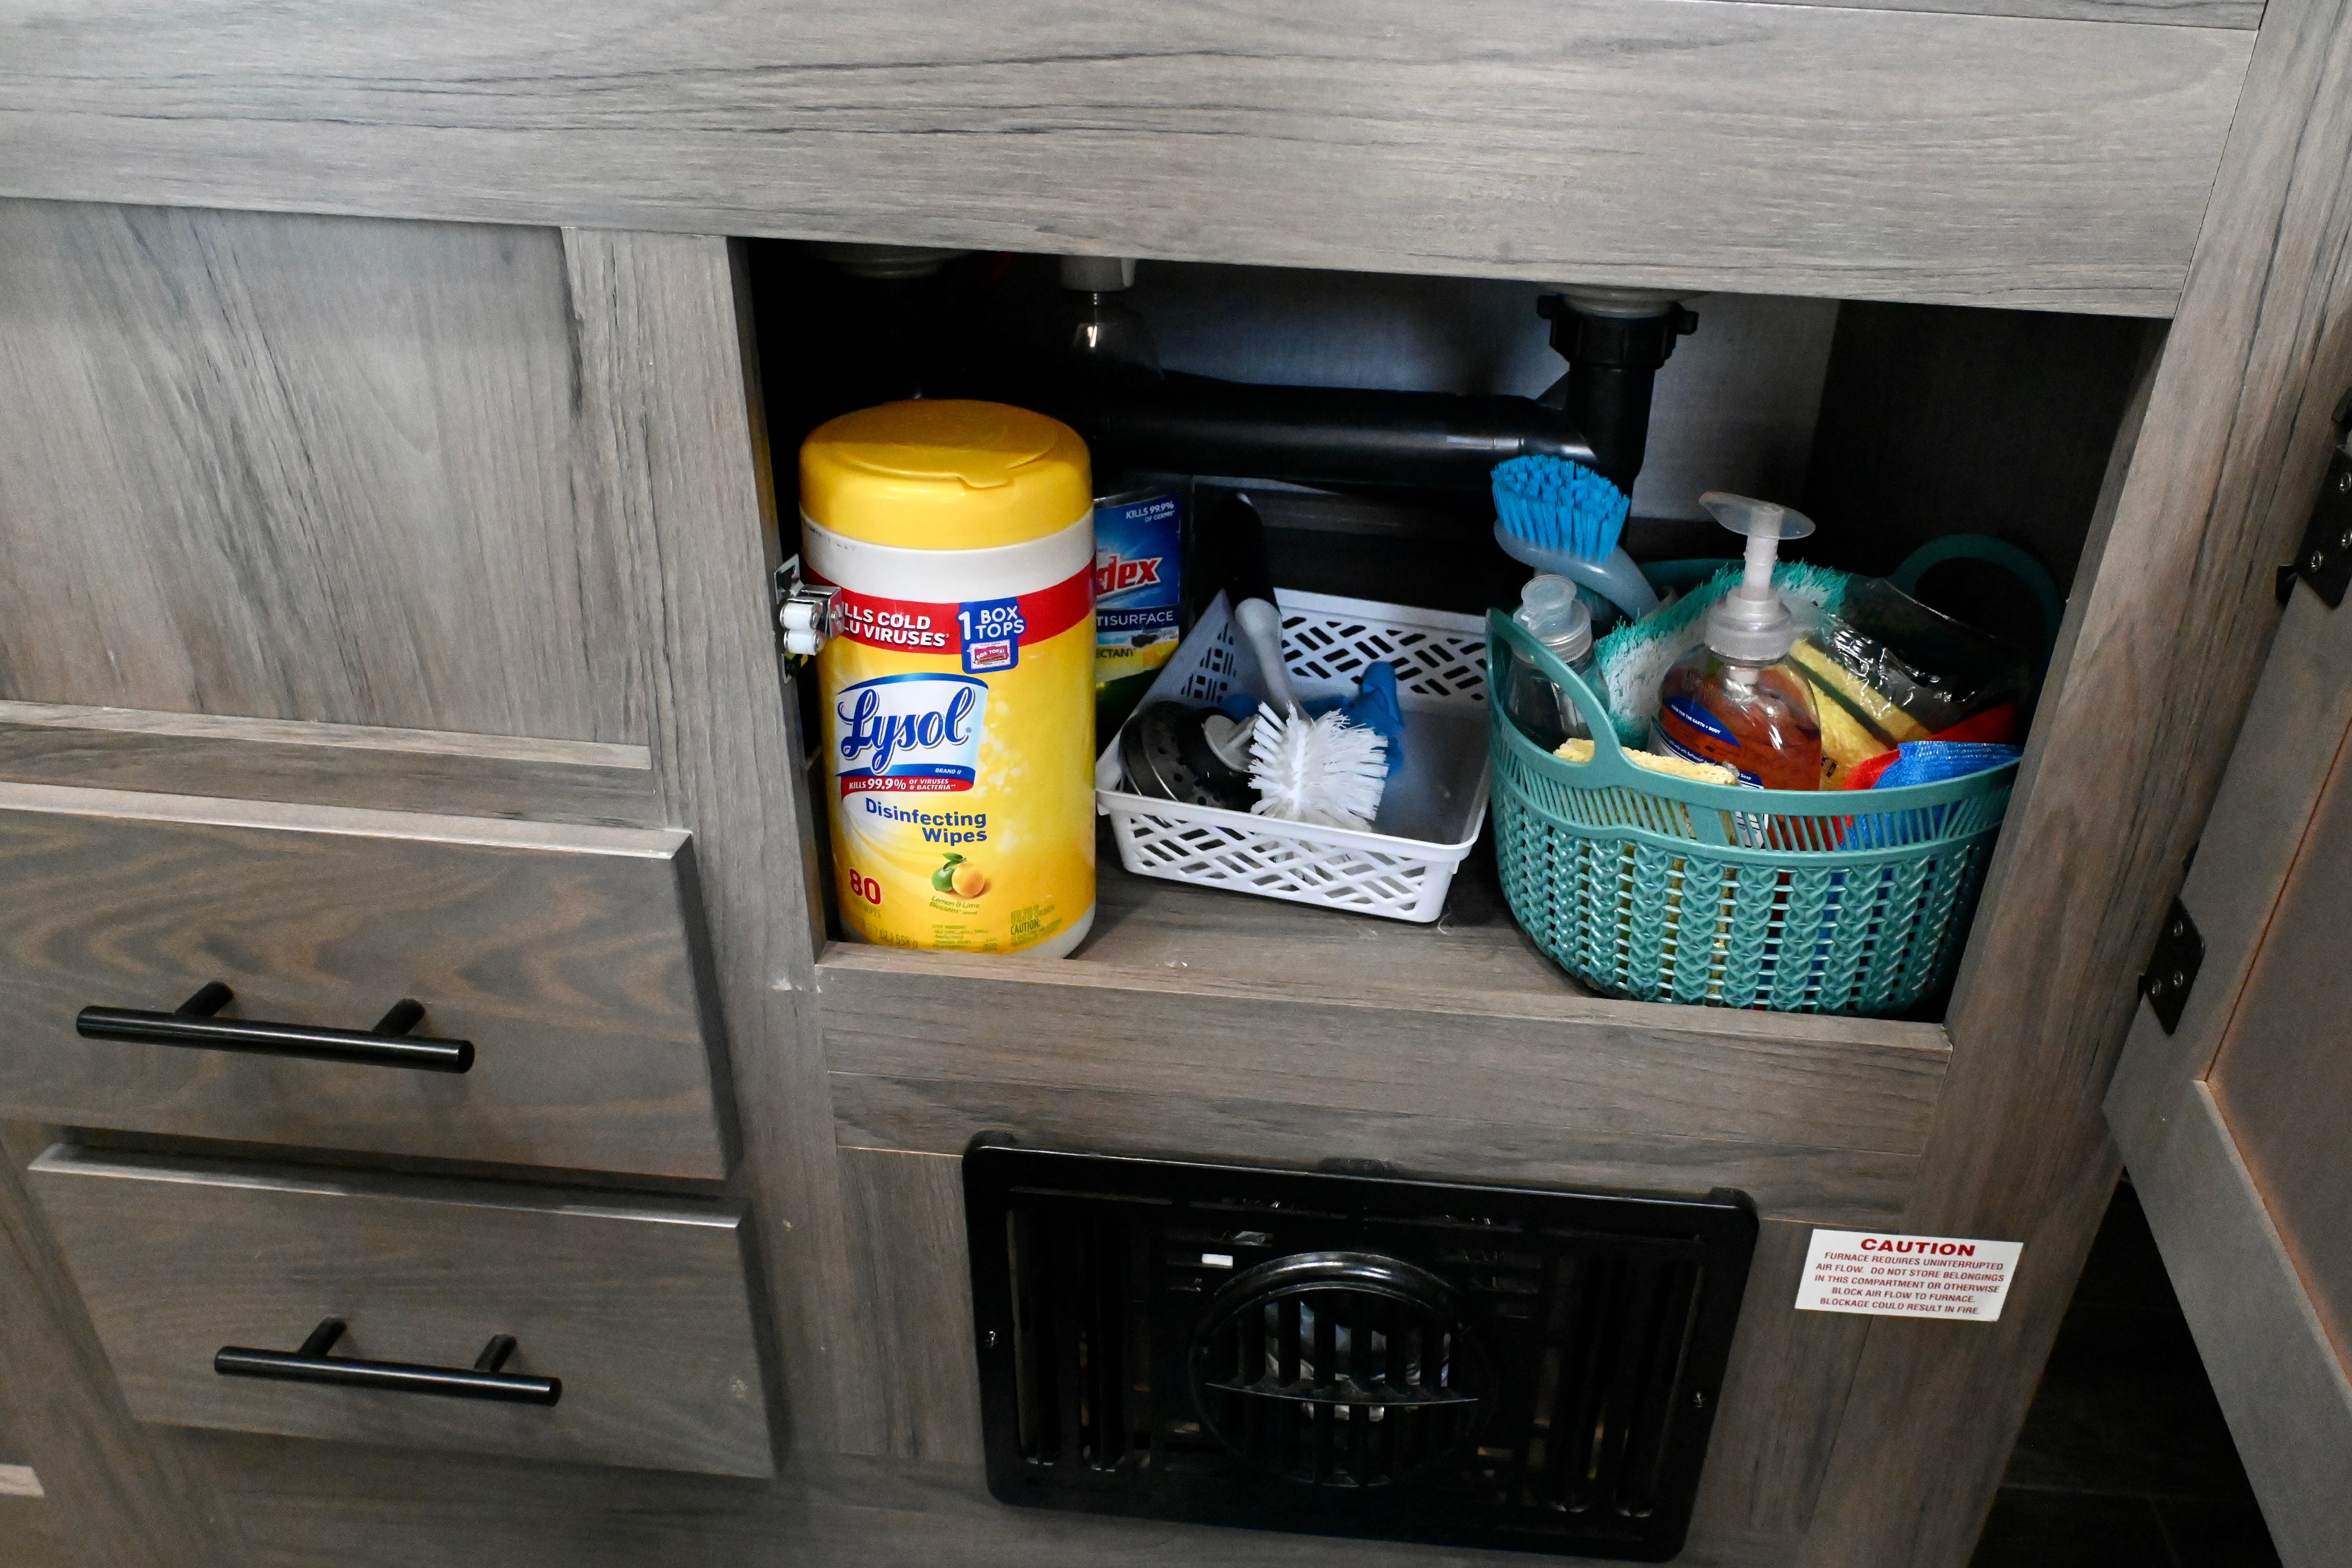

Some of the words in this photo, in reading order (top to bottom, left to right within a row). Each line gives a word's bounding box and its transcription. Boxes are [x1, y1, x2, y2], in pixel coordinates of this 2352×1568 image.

[1126, 507, 1149, 519] KILLS
[1149, 501, 1174, 514] 99.9%
[1097, 554, 1159, 595] dex
[842, 602, 874, 623] LLS
[877, 612, 931, 630] COLD
[958, 611, 971, 640] 1
[980, 605, 1018, 624] BOX
[1097, 611, 1174, 627] TISURFACE
[975, 619, 1024, 639] TOPS
[976, 651, 988, 659] BOX
[1692, 719, 1705, 728] EARTH
[1708, 726, 1721, 734] BODY
[849, 781, 866, 790] KILLS
[867, 778, 906, 790] 99.9%
[865, 797, 986, 828] Disinfecting
[922, 827, 988, 846] Wipes
[849, 867, 882, 905] 80
[931, 896, 954, 906] Lemon
[1860, 1238, 1976, 1257] CAUTION
[1825, 1252, 1869, 1262] FURNACE
[1872, 1256, 1920, 1265] REQUIRES
[1923, 1258, 2003, 1270] UNINTERRUPTED
[1816, 1263, 1832, 1271] AIR
[1909, 1269, 1941, 1278] STORE
[1943, 1271, 2005, 1281] BELONGINGS
[1828, 1275, 1849, 1283] THIS
[1851, 1277, 1925, 1288] COMPARTMENT
[1944, 1283, 2000, 1293] OTHERWISE
[1831, 1287, 1863, 1296] BLOCK
[1820, 1297, 1869, 1308] BLOCKAGE
[1872, 1301, 1904, 1310] COULD
[1906, 1303, 1942, 1312] RESULT
